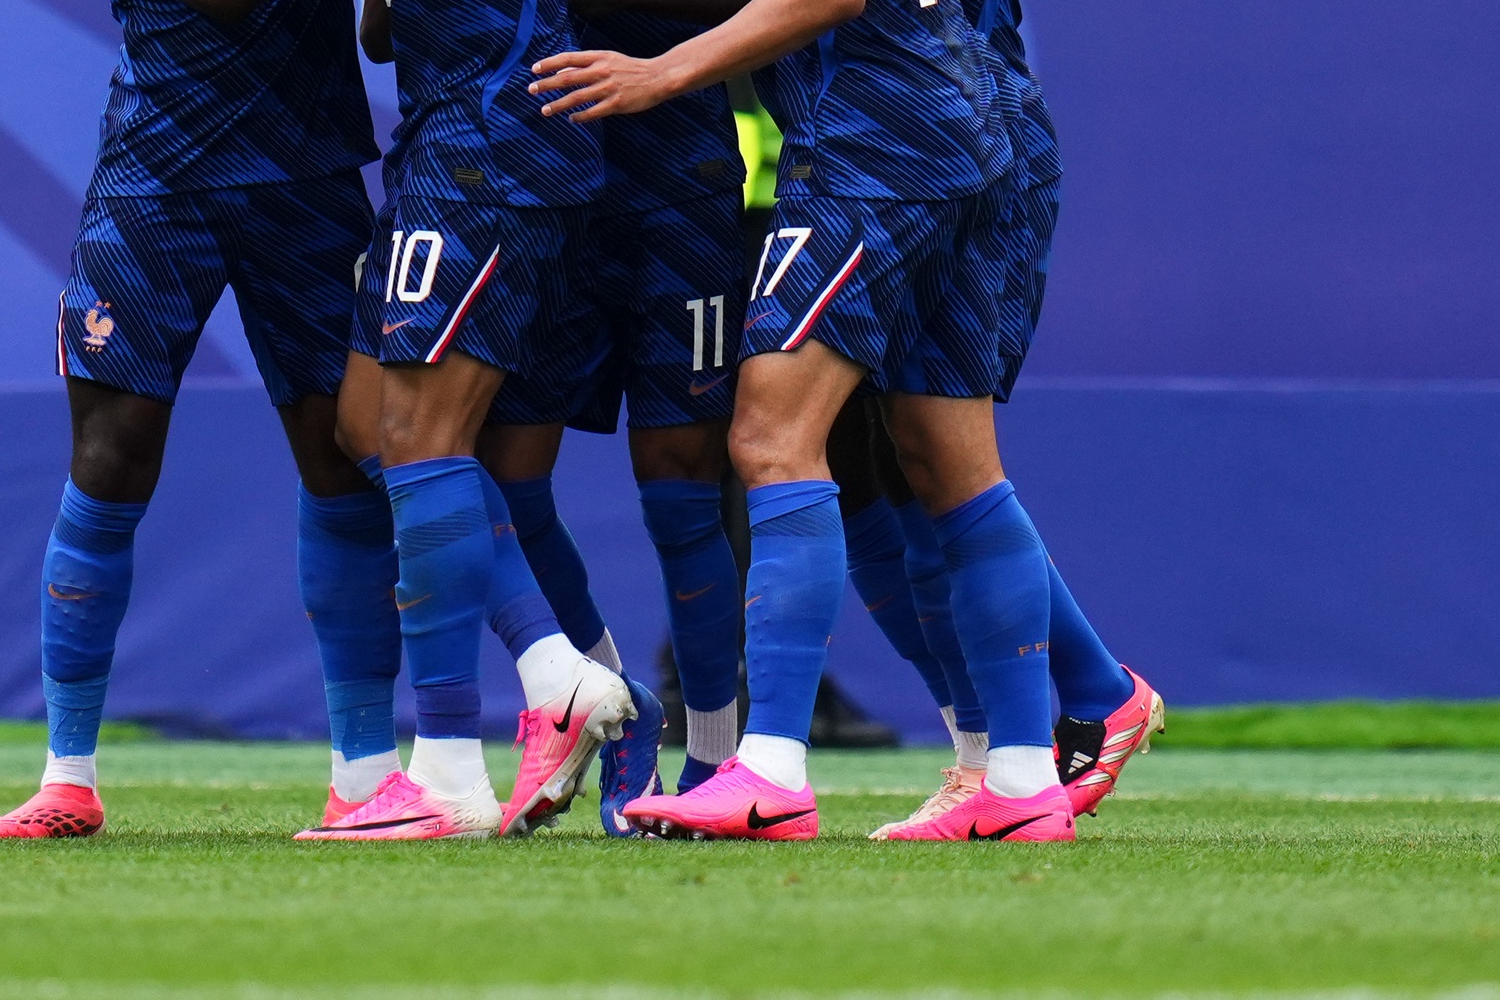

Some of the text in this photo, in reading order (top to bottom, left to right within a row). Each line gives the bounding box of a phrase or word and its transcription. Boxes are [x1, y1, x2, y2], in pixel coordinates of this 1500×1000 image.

[386, 230, 443, 302] 10
[751, 227, 812, 301] 17
[686, 295, 724, 371] 11
[1018, 643, 1049, 657] FF
